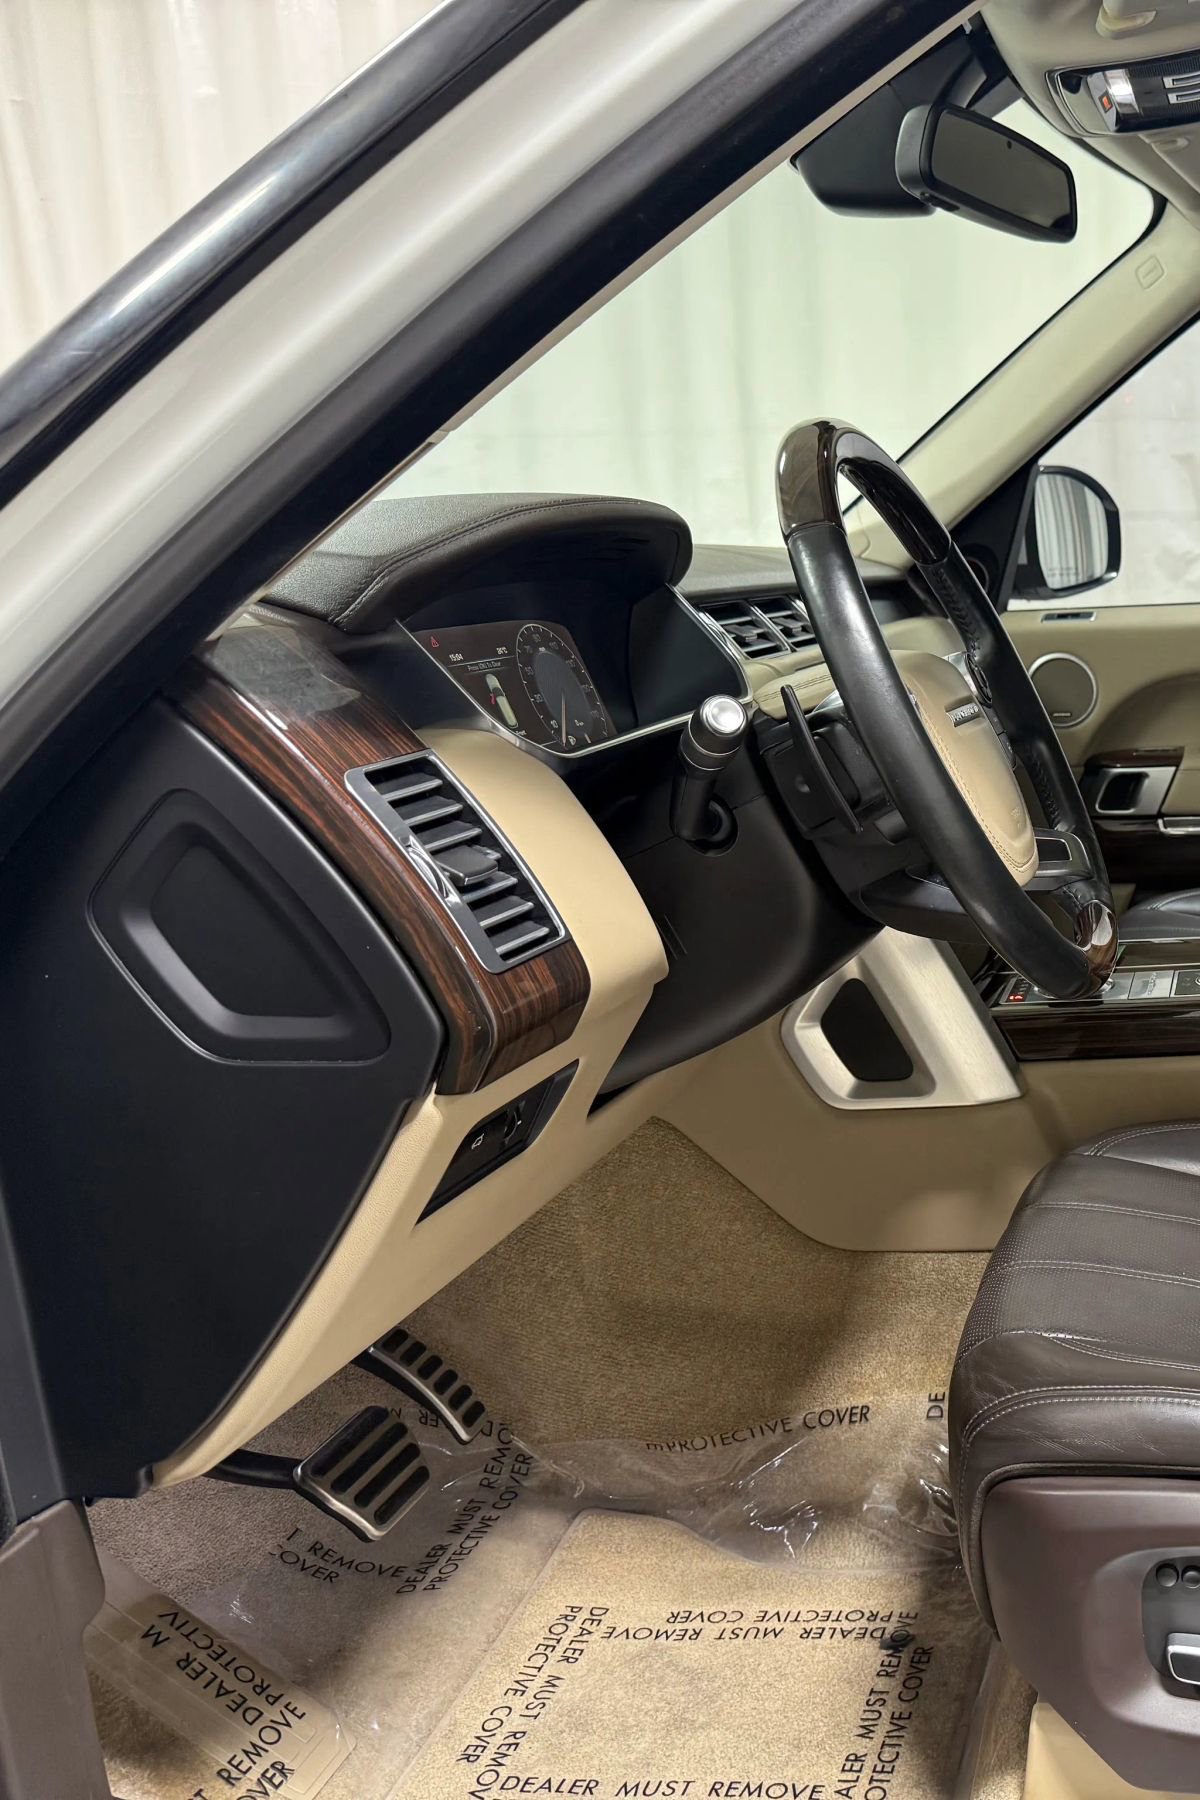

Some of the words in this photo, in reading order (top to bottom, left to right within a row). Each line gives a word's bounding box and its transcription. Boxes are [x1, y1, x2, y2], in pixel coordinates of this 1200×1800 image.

[802, 1405, 871, 1430] COVER
[396, 1542, 453, 1595] DEALER
[446, 1498, 486, 1536] MUST
[478, 1423, 516, 1490] REMO
[423, 1514, 500, 1592] PROTECTIVE
[491, 1452, 535, 1512] COVER
[269, 1543, 340, 1584] OVER
[307, 1541, 408, 1578] REMOVE
[556, 1606, 610, 1664] DEALER
[600, 1626, 703, 1641] REMOVE
[666, 1610, 744, 1624] COVER
[714, 1627, 784, 1640] MUST
[753, 1610, 894, 1623] PROTECTIVE
[799, 1626, 887, 1640] DEALER
[503, 1605, 584, 1698] PROTECTIVE
[897, 1645, 935, 1704] COVER
[176, 1652, 265, 1726] DEALER
[519, 1674, 566, 1720] MUST
[854, 1687, 890, 1740] MUST
[216, 1701, 307, 1787] REMOVE
[456, 1705, 513, 1764] COVER
[467, 1730, 528, 1800] REMOV
[499, 1775, 600, 1796] DEALER
[614, 1779, 695, 1797] MUST
[707, 1780, 826, 1800] REMOVE
